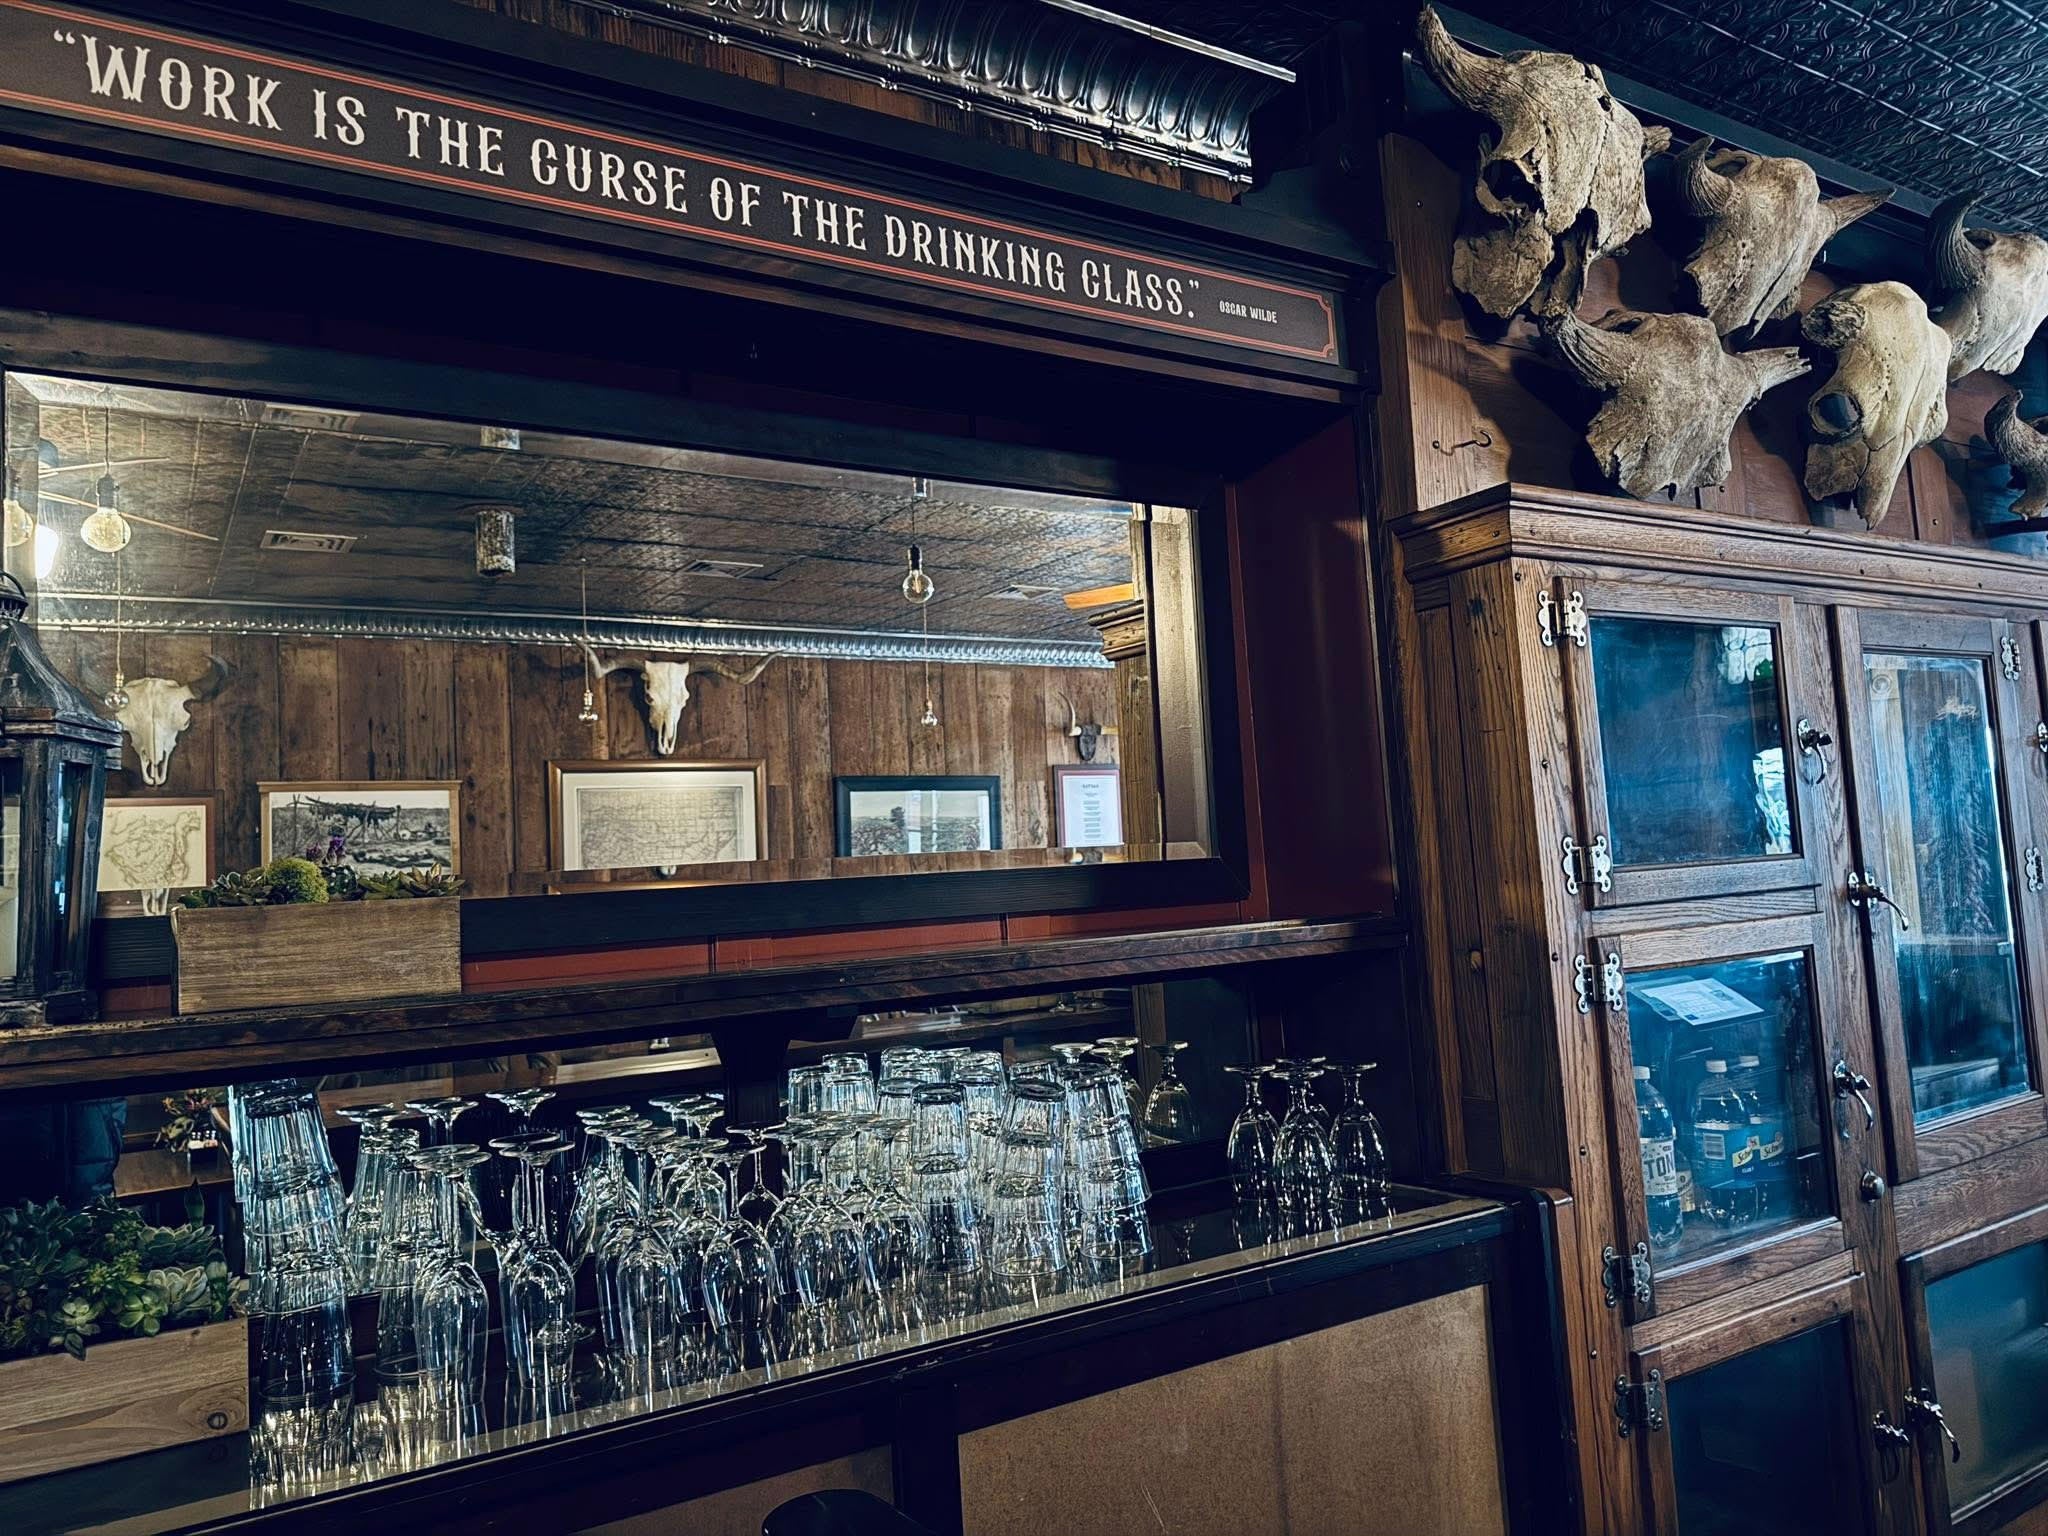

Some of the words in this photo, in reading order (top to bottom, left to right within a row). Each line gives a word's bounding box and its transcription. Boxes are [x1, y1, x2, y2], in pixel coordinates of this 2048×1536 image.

[53, 29, 283, 132] “WORK
[312, 88, 367, 146] IS
[395, 106, 505, 177] THE
[529, 138, 689, 214] CURSE
[709, 177, 761, 227] OF
[781, 191, 867, 251] THE
[883, 214, 1066, 293] DRINKING
[1219, 300, 1247, 318] OSCAR
[1249, 306, 1278, 324] WILDE
